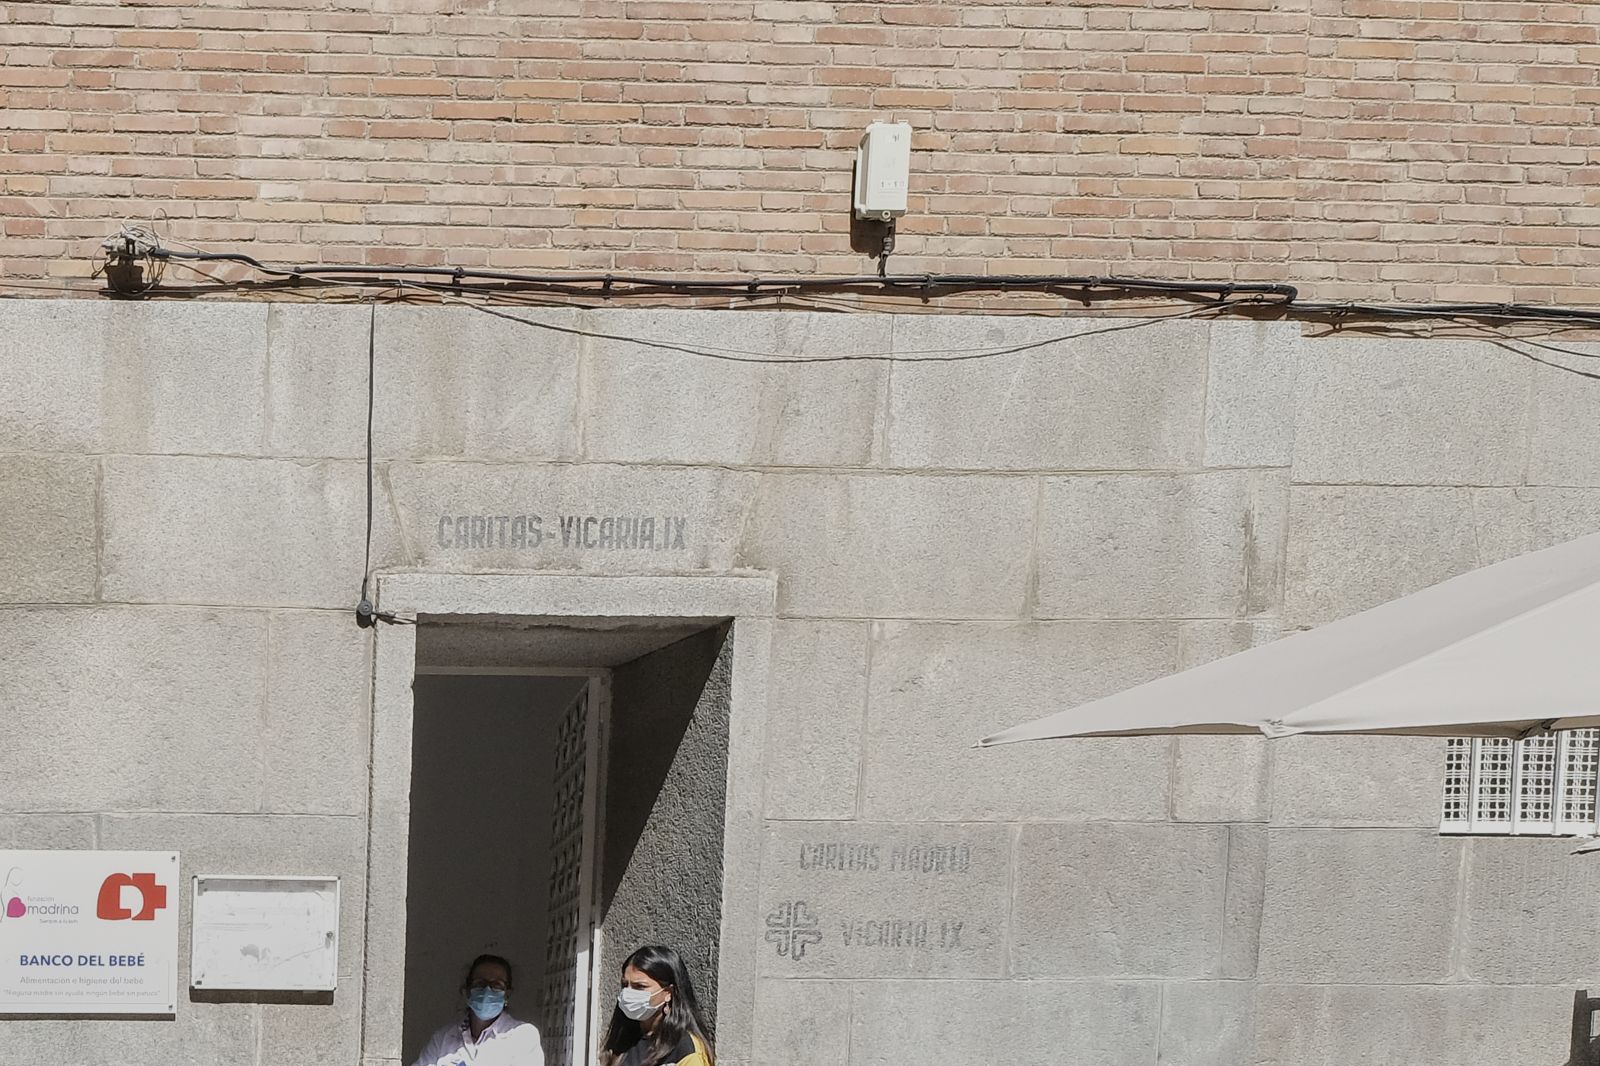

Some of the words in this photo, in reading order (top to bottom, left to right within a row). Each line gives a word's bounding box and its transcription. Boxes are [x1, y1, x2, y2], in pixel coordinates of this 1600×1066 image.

[27, 903, 80, 915] madrina
[19, 954, 73, 967] BANCO
[77, 954, 105, 967] DEL
[108, 951, 146, 967] BEBÉ
[78, 975, 107, 987] higiene
[109, 975, 122, 985] del
